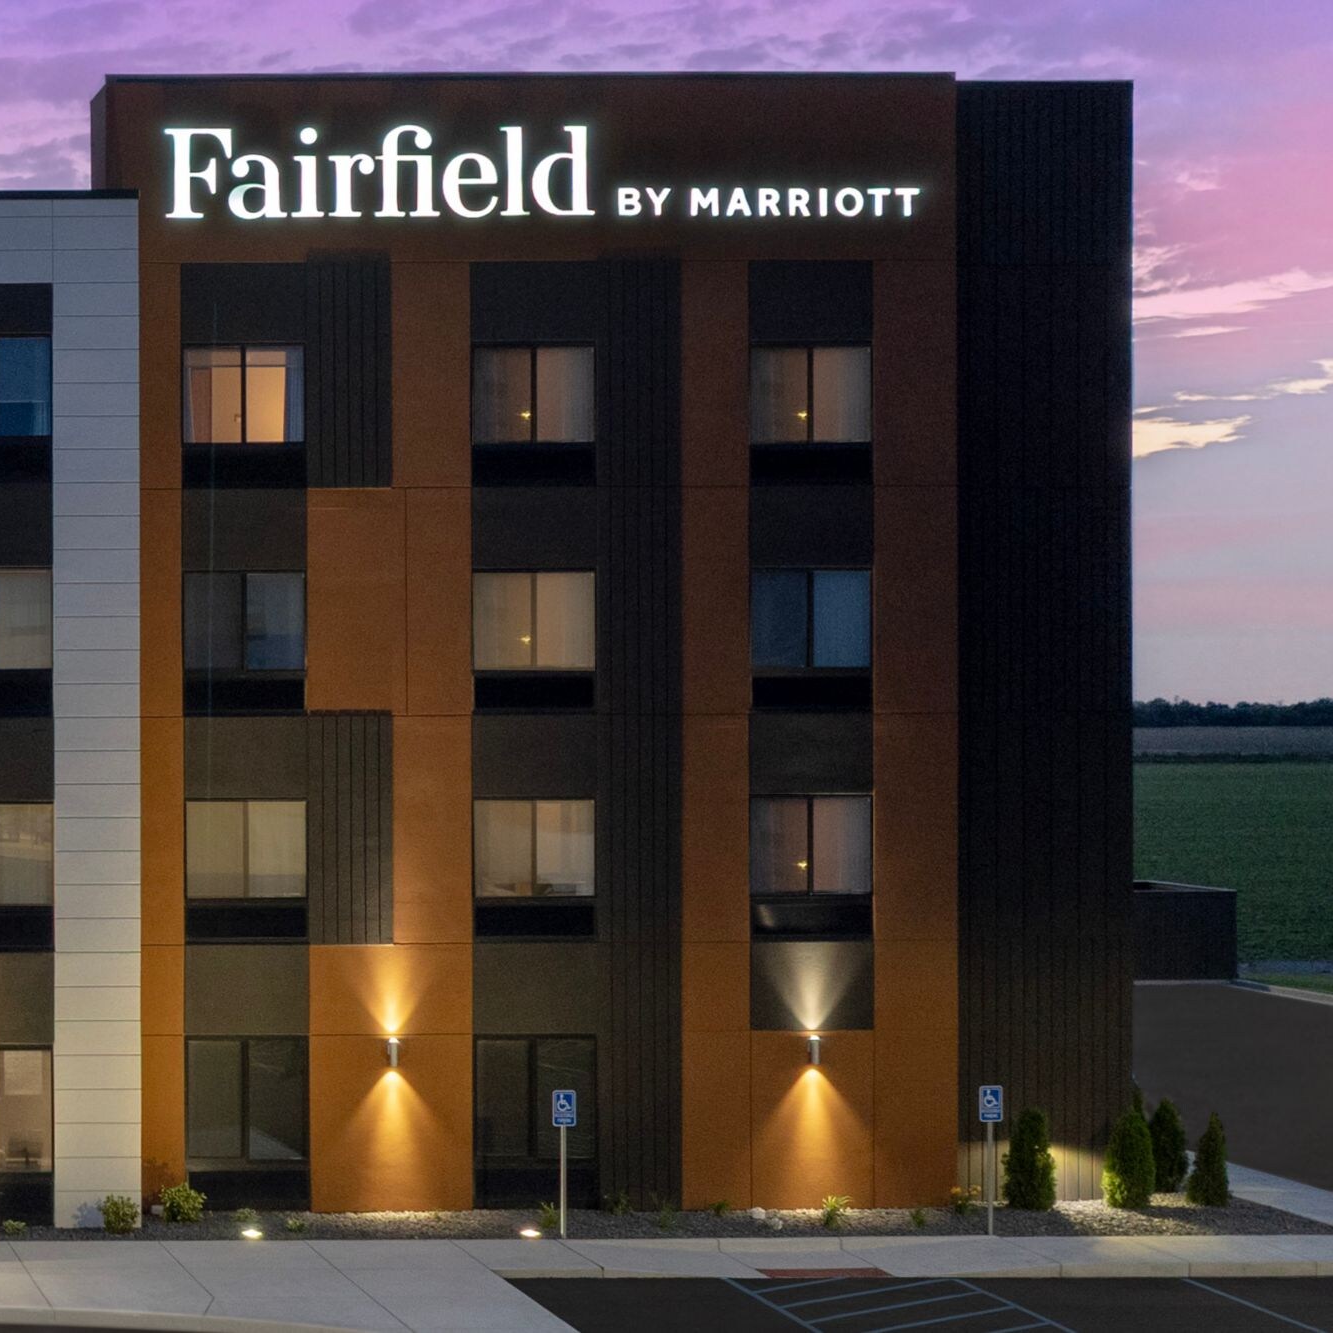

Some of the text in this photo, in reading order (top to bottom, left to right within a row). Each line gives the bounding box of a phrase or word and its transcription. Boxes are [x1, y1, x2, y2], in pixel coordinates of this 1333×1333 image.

[164, 125, 920, 219] Fairfield BY MARRIOTT
